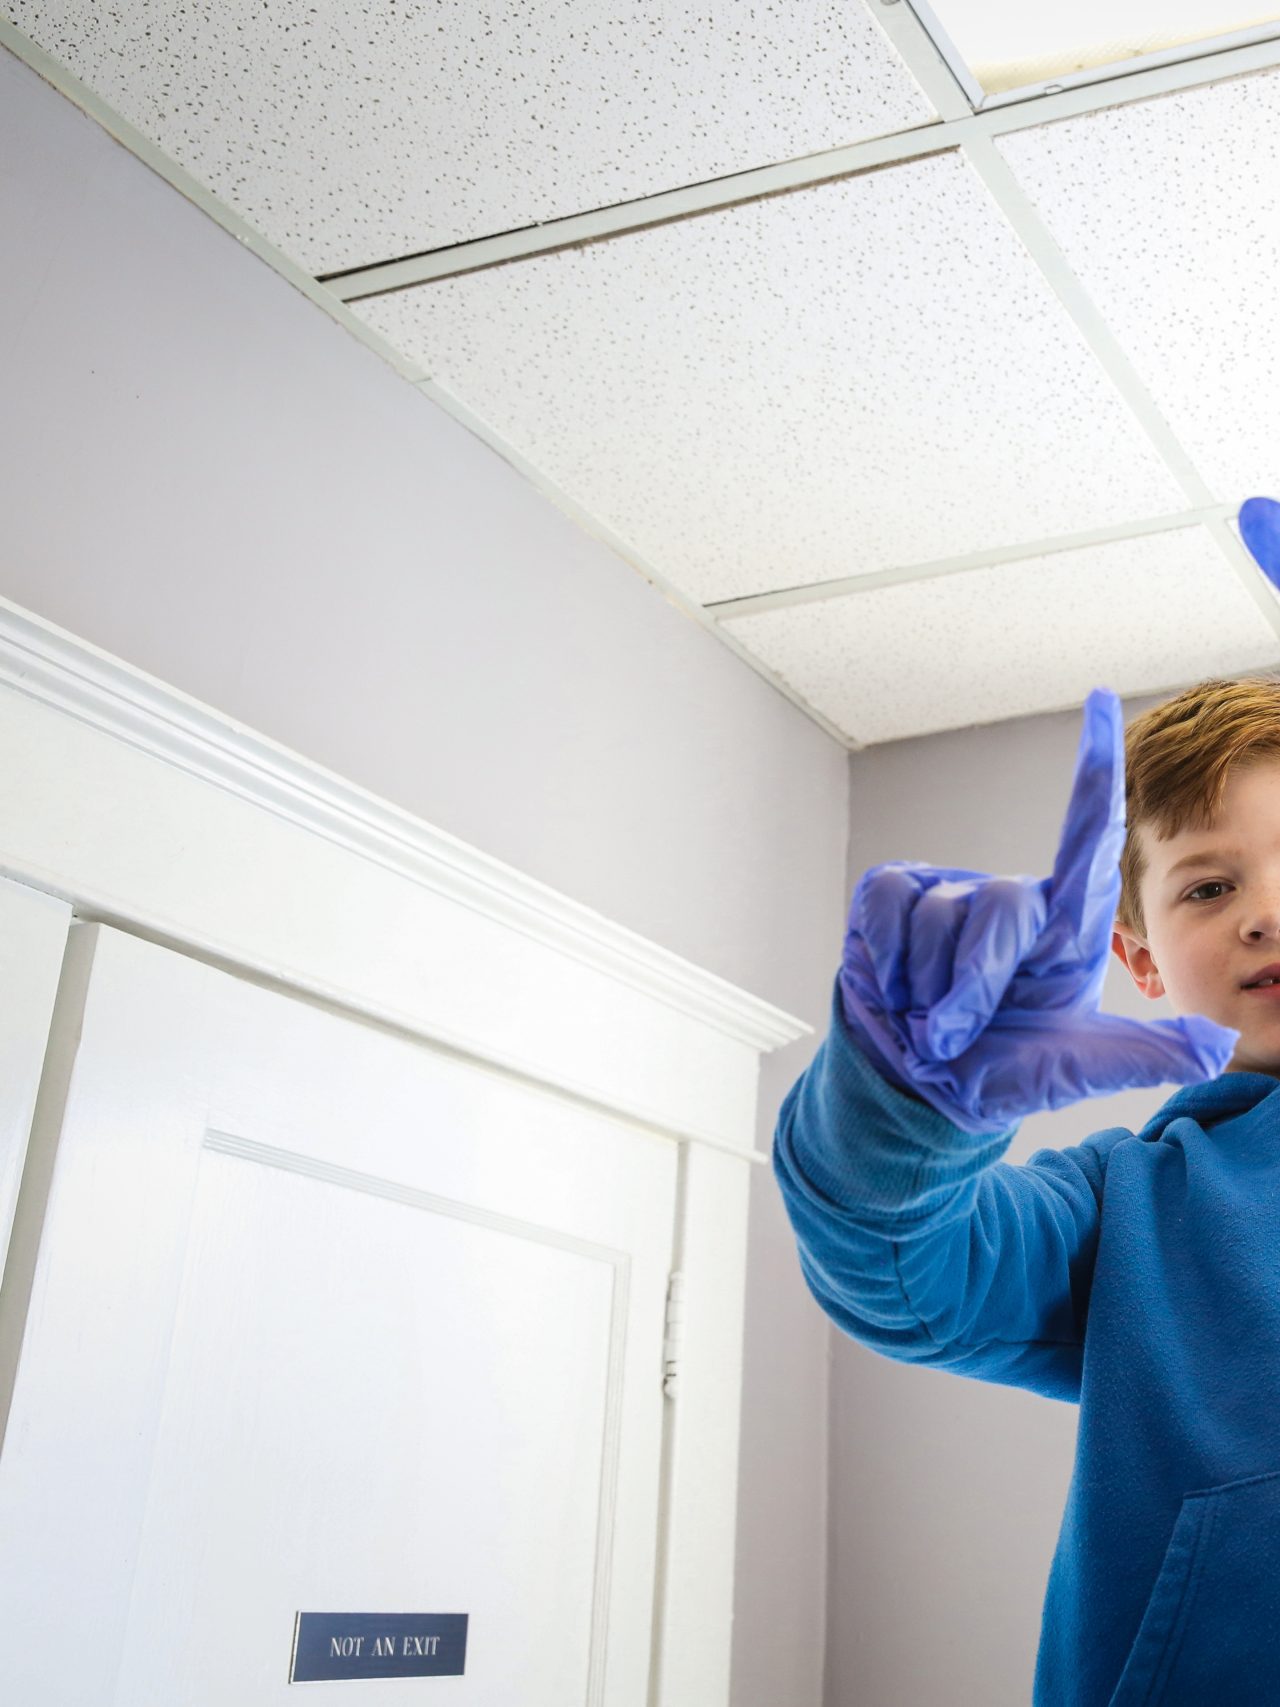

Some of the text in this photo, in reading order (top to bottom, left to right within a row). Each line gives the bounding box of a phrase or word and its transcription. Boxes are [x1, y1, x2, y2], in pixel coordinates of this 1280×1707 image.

[330, 1636, 440, 1657] NOT AN EXIT
